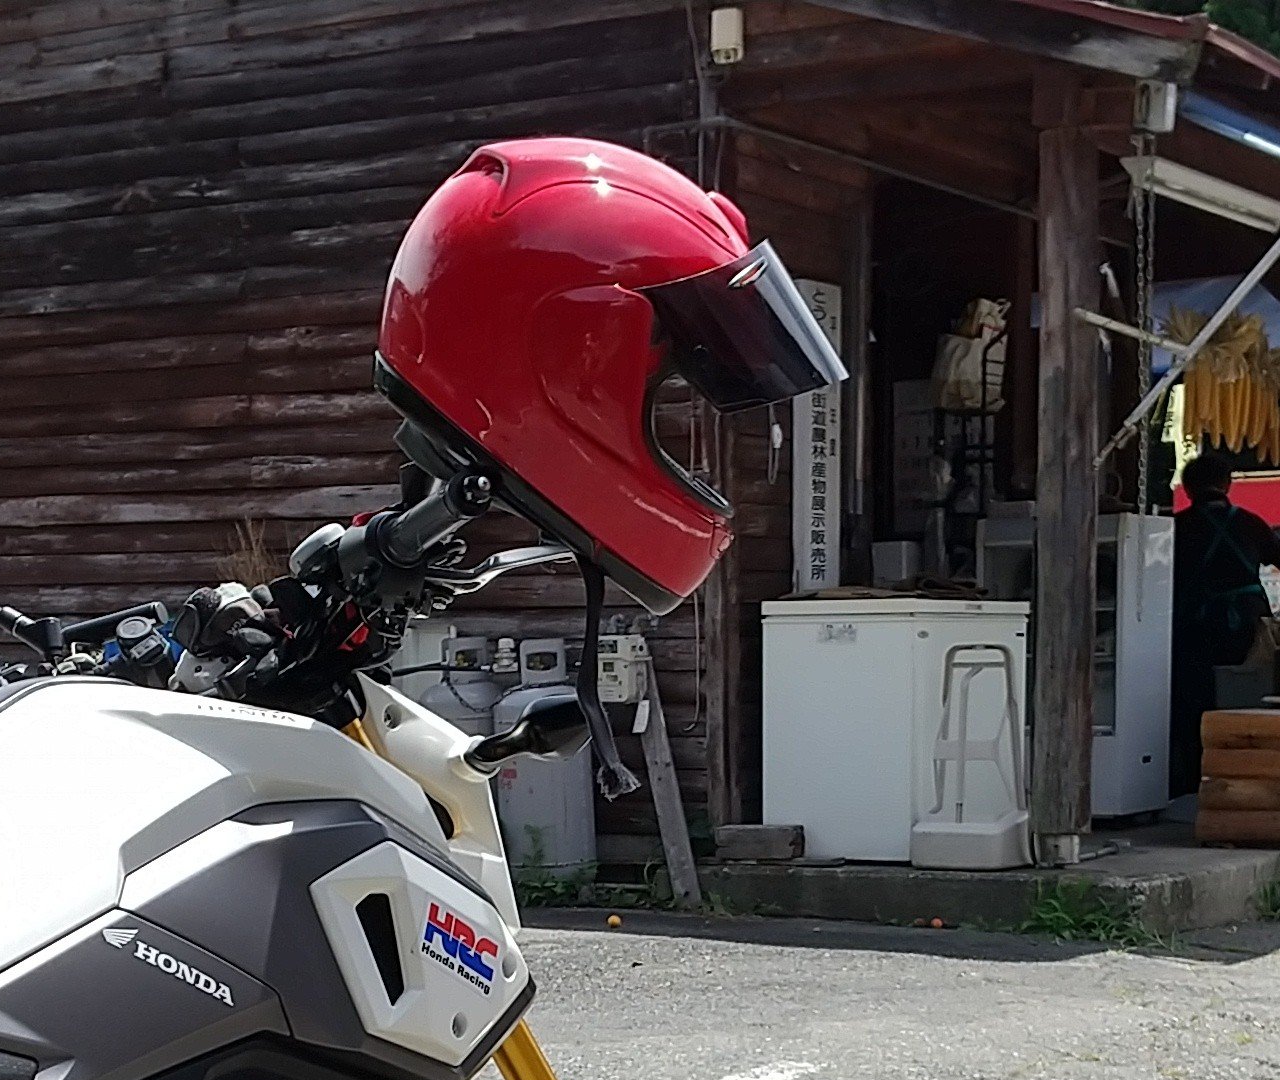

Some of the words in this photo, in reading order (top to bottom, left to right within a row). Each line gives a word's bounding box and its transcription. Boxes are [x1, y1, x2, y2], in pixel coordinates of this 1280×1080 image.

[133, 940, 235, 1007] HONDA
[421, 942, 455, 971] Honda
[457, 964, 491, 995] Racing
[423, 901, 499, 982] HRC
